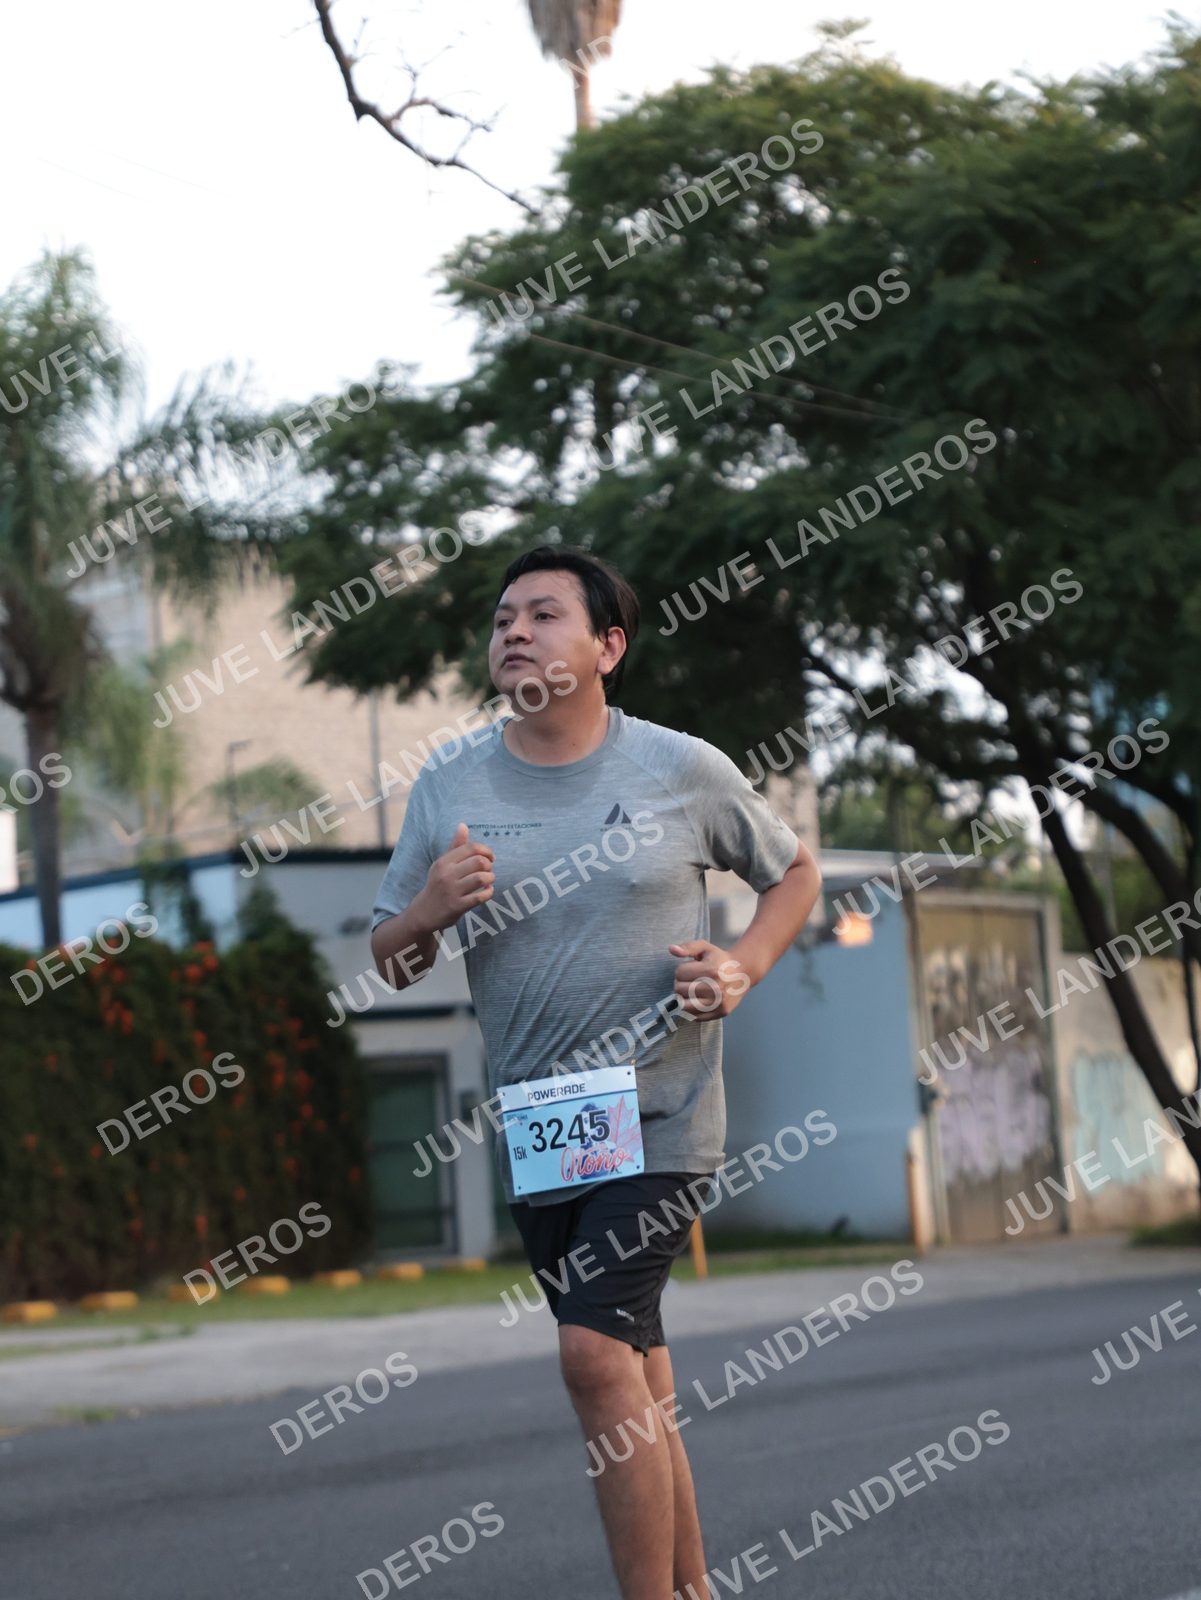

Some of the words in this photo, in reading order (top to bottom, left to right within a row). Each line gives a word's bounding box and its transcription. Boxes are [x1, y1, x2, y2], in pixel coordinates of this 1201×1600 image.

[528, 1083, 586, 1101] POWERADE
[528, 1109, 611, 1153] 3245
[513, 1145, 528, 1161] 15k
